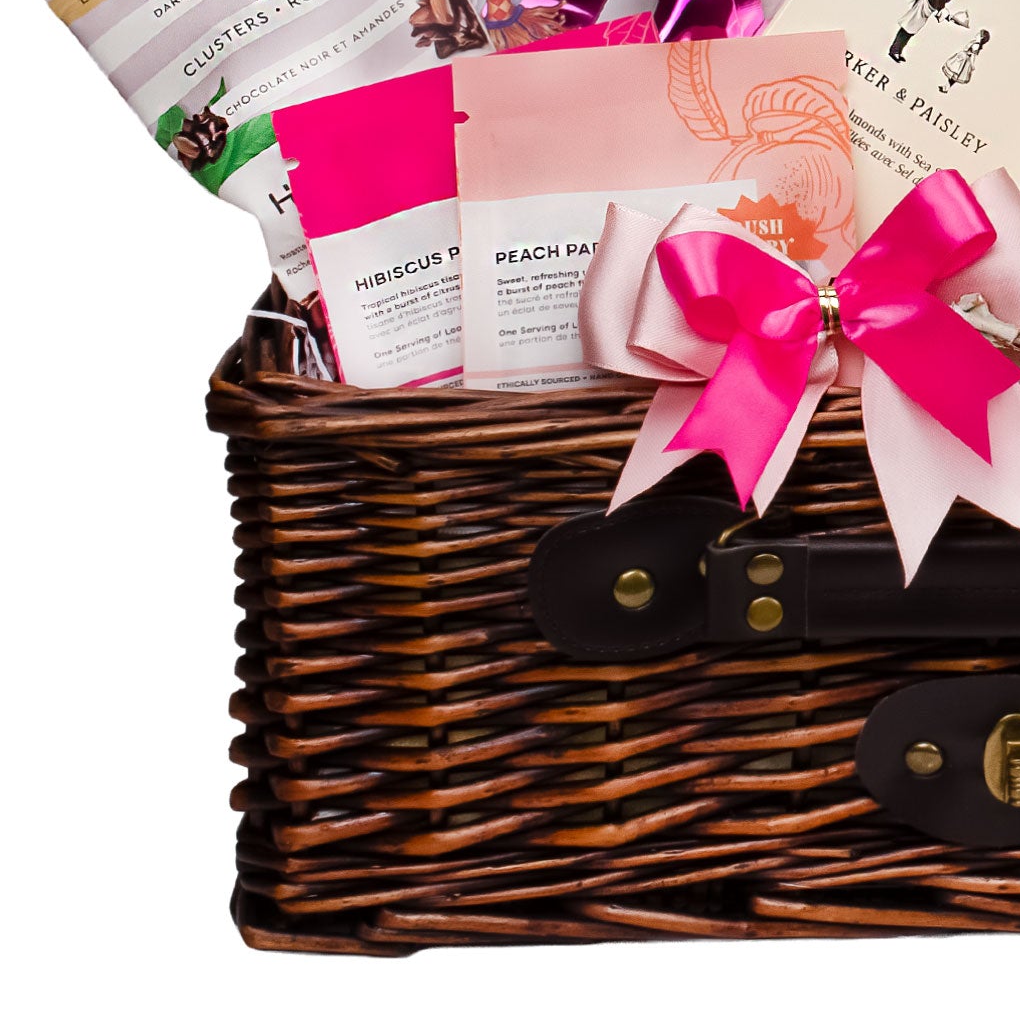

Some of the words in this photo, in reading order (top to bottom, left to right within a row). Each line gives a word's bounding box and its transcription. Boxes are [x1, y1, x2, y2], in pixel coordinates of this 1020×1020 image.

[183, 10, 270, 77] CLUSTERS
[225, 67, 296, 117] CHOCOLATE
[300, 50, 331, 71] NOIR
[333, 40, 348, 54] ET
[352, 0, 405, 42] AMANDES
[894, 87, 907, 103] &
[909, 96, 988, 155] PAISLEY
[870, 148, 896, 169] avec
[895, 164, 914, 180] Sel
[888, 137, 912, 159] with
[913, 154, 932, 173] Sea
[495, 244, 560, 265] PEACH
[355, 252, 442, 292] HIBISCUS
[506, 285, 531, 295] burst
[533, 282, 543, 291] of
[545, 280, 575, 291] peach
[531, 269, 580, 282] refreshing
[361, 292, 399, 311] Tropical
[400, 280, 440, 298] hibiscus
[364, 309, 384, 321] with
[394, 297, 419, 310] burst
[421, 292, 431, 302] of
[433, 284, 461, 297] citrus
[373, 348, 393, 359] One
[395, 334, 431, 353] Serving
[433, 329, 442, 340] of
[498, 329, 517, 337] One
[520, 323, 557, 335] Serving
[559, 322, 569, 331] of
[496, 378, 539, 390] ETHICALLY
[541, 375, 581, 385] SOURCED
